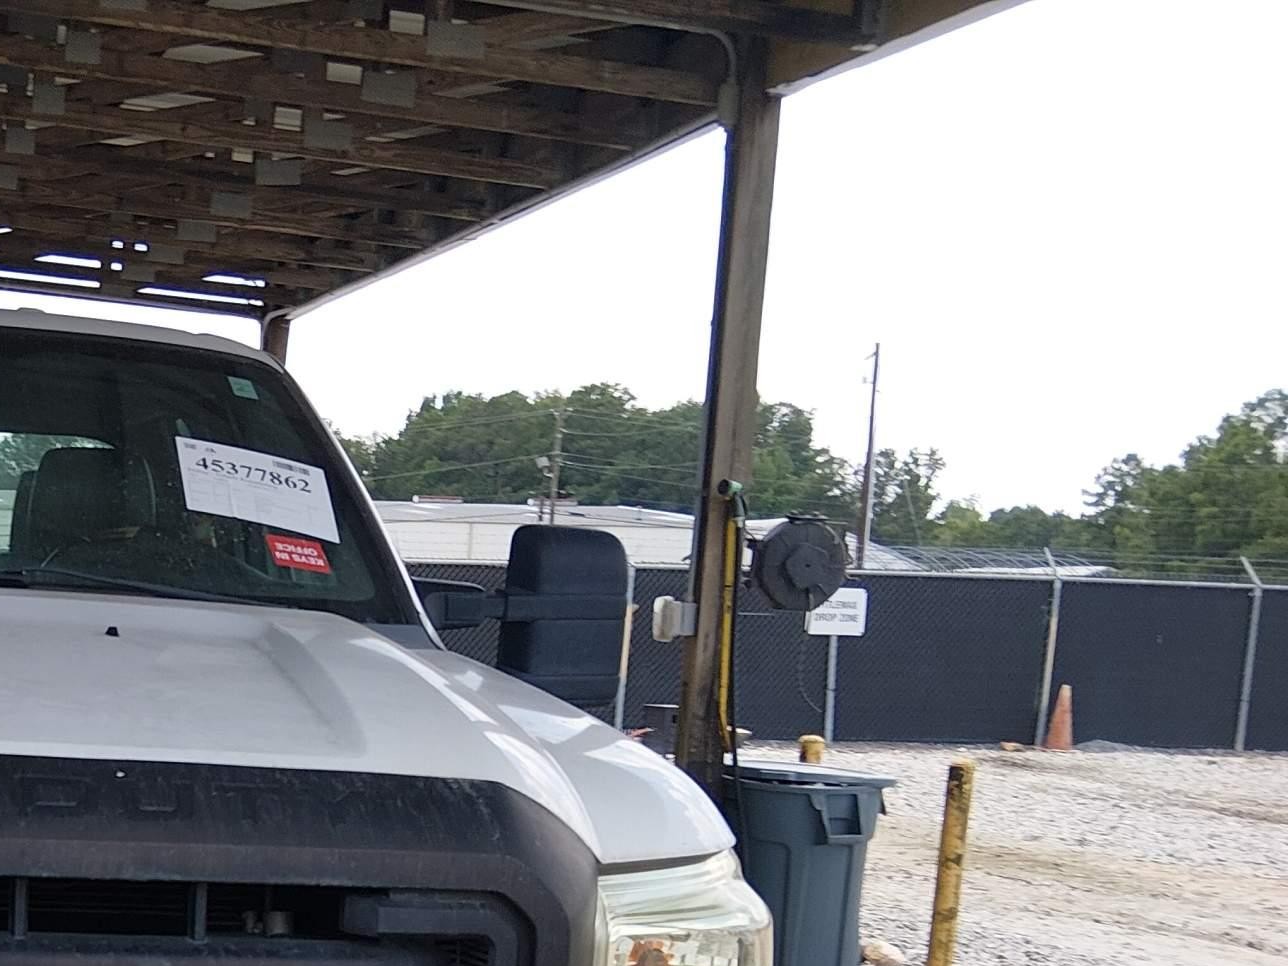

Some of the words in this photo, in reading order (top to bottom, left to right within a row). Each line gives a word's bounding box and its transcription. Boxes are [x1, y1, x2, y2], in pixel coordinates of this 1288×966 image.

[195, 457, 311, 493] 45377862
[274, 542, 318, 556] OFFICE
[274, 551, 290, 562] IN
[291, 554, 325, 567] KEYS
